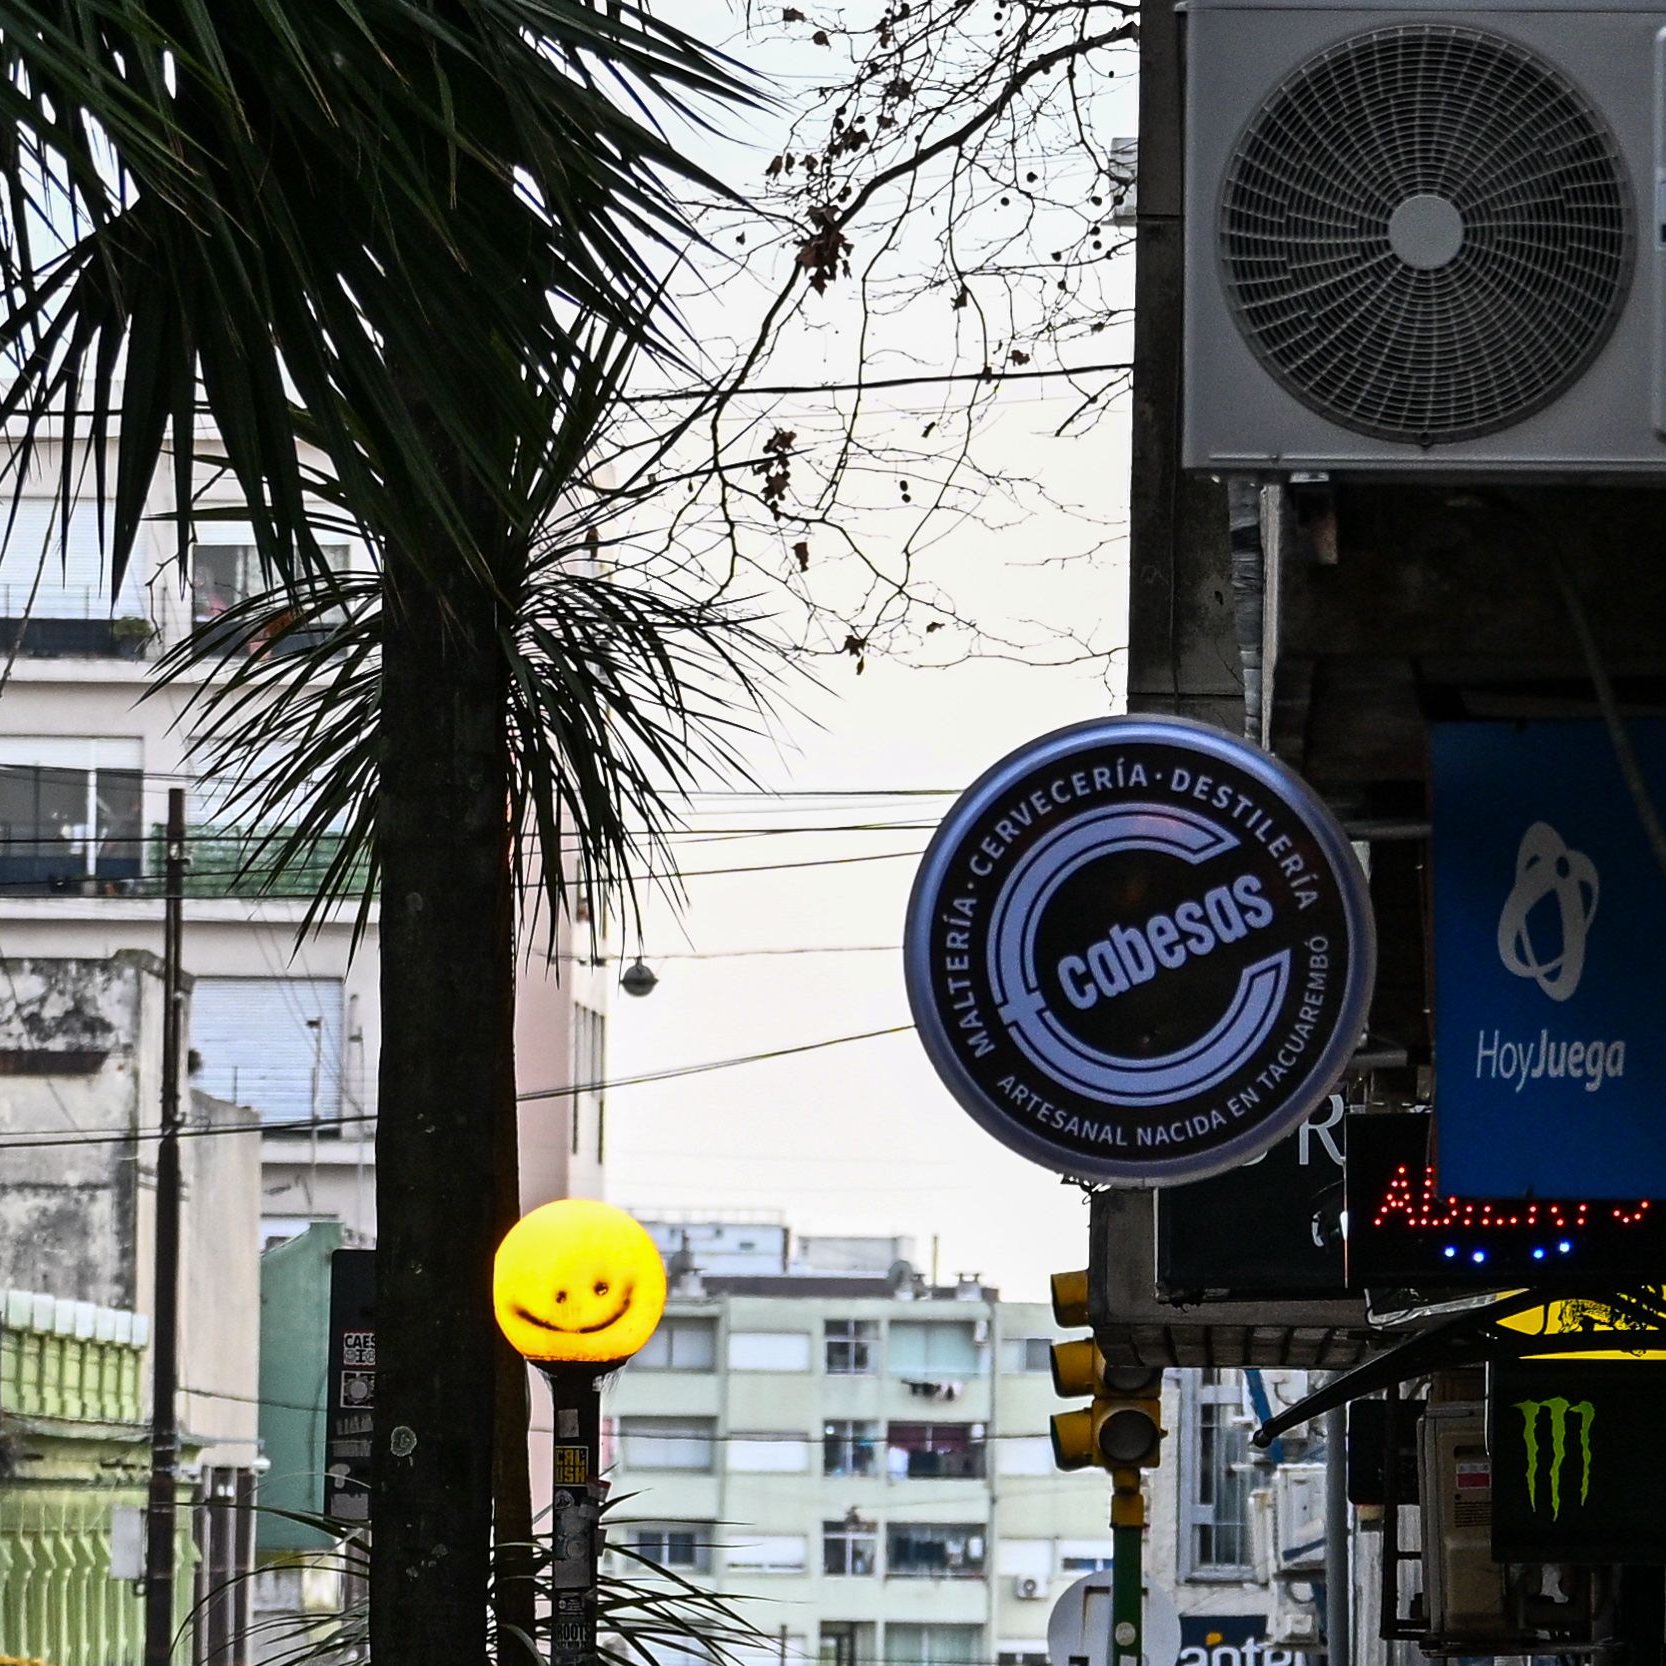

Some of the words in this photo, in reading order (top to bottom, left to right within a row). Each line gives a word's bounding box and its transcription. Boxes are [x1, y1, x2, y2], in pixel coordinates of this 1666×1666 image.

[942, 897, 995, 1059] MALTERÍA
[970, 758, 1147, 876] CERVECERÍA
[1171, 767, 1321, 910] DESTILERÍA
[1057, 873, 1275, 1011] cabesas
[997, 1073, 1128, 1147] ARTESANAL
[1136, 1111, 1225, 1147] NACIDA
[1231, 1088, 1260, 1119] EN
[1256, 935, 1329, 1090] TACUAREMBÓ
[1476, 1029, 1626, 1093] HoyJuega
